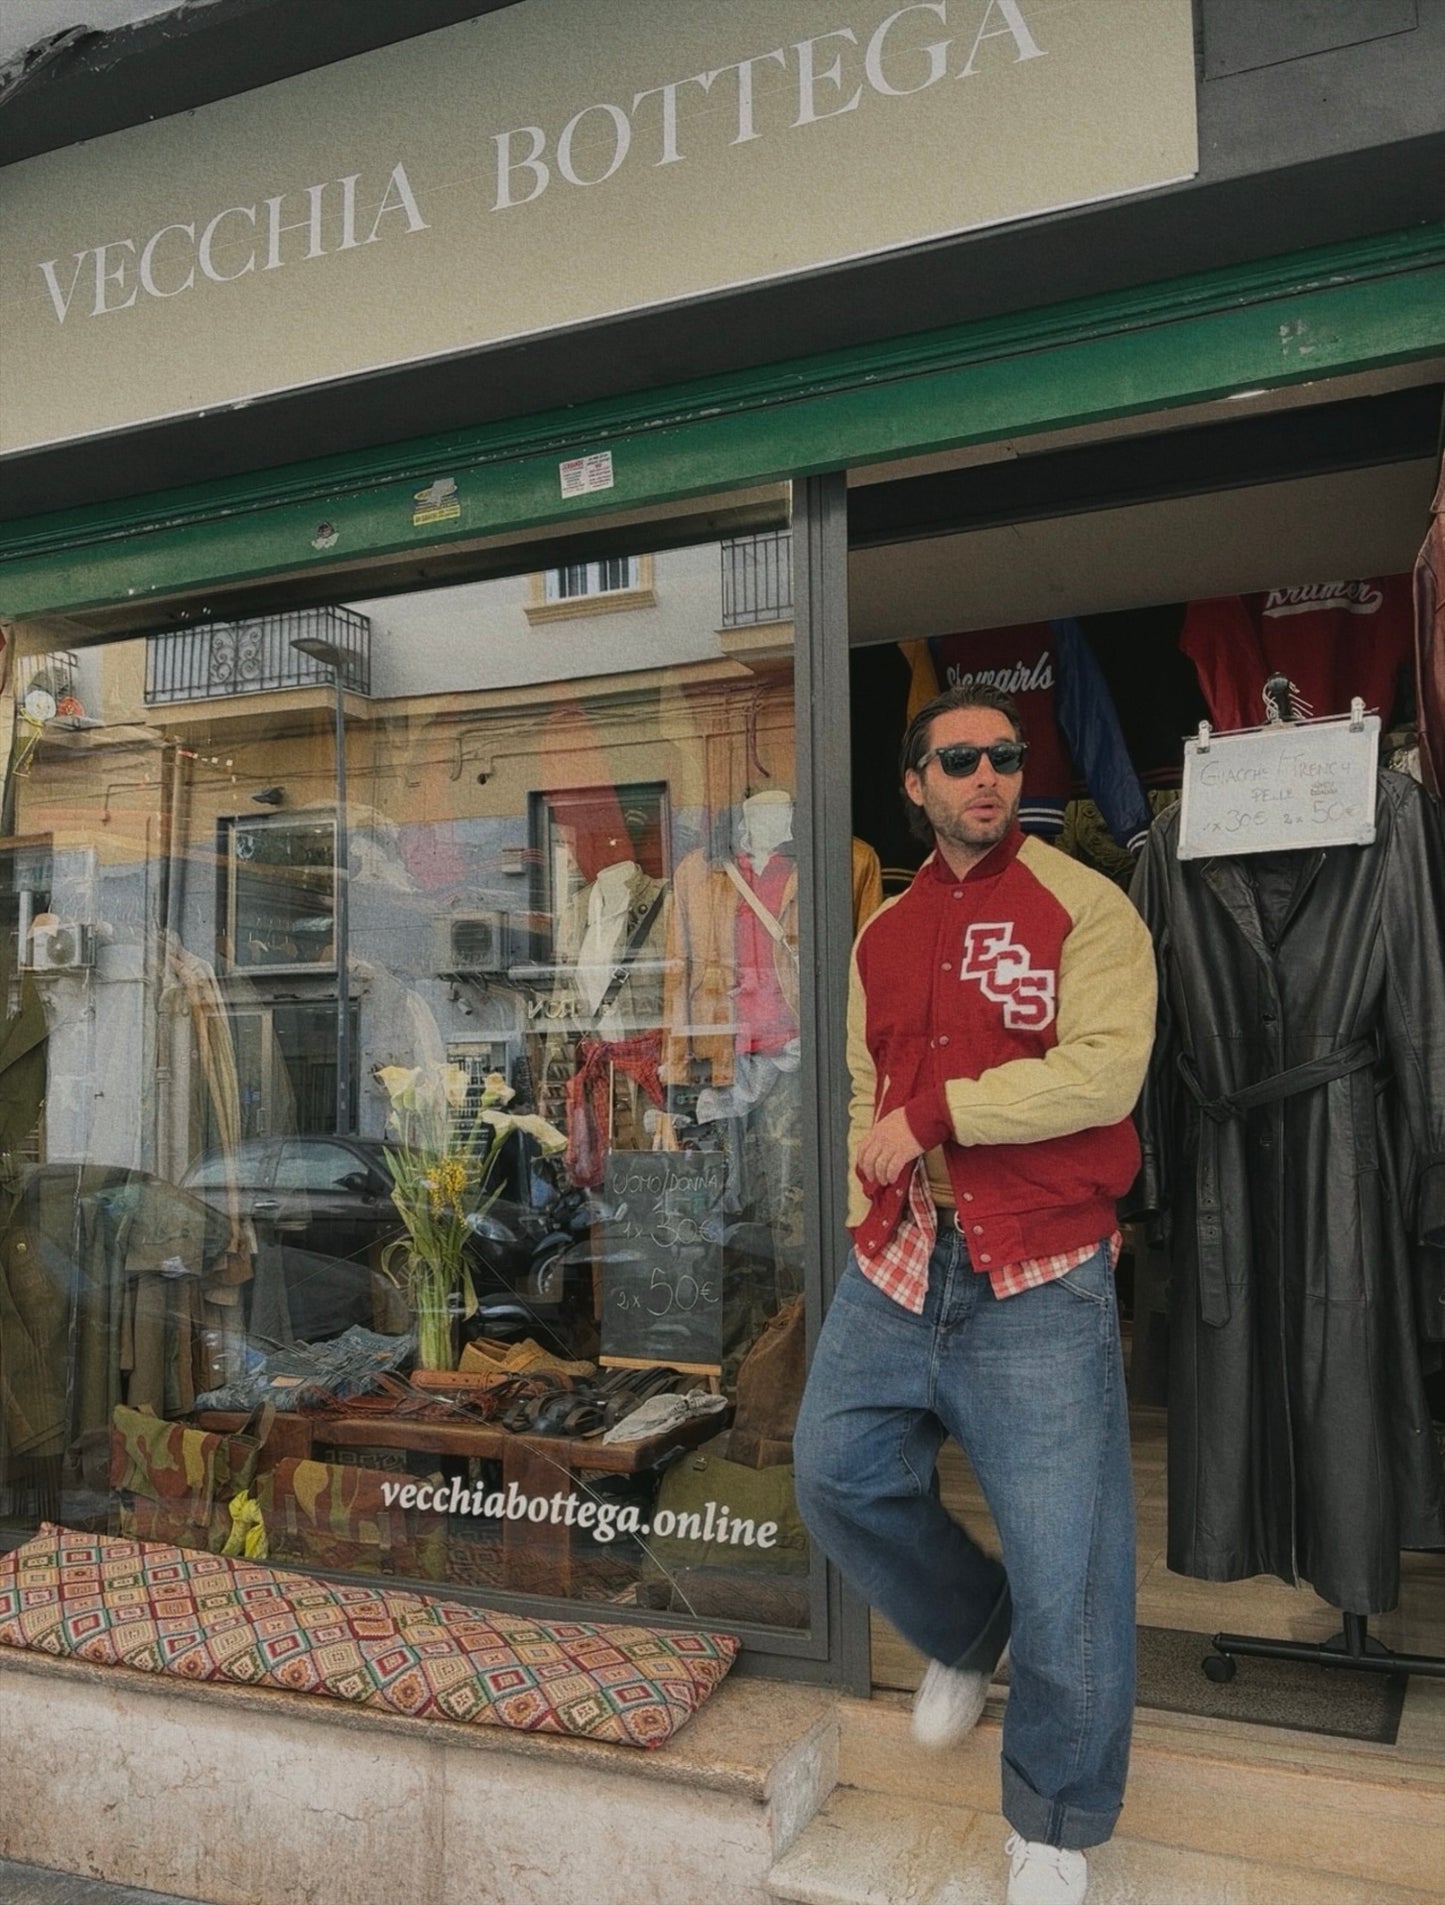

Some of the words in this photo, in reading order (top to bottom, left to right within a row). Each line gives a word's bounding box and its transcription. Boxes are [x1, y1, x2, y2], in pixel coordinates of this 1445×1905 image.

[39, 161, 431, 325] VECCHIA
[489, 0, 1049, 212] BOTTEGA
[647, 1267, 719, 1316] 50€
[380, 1476, 778, 1548] vecchiabottega.online
